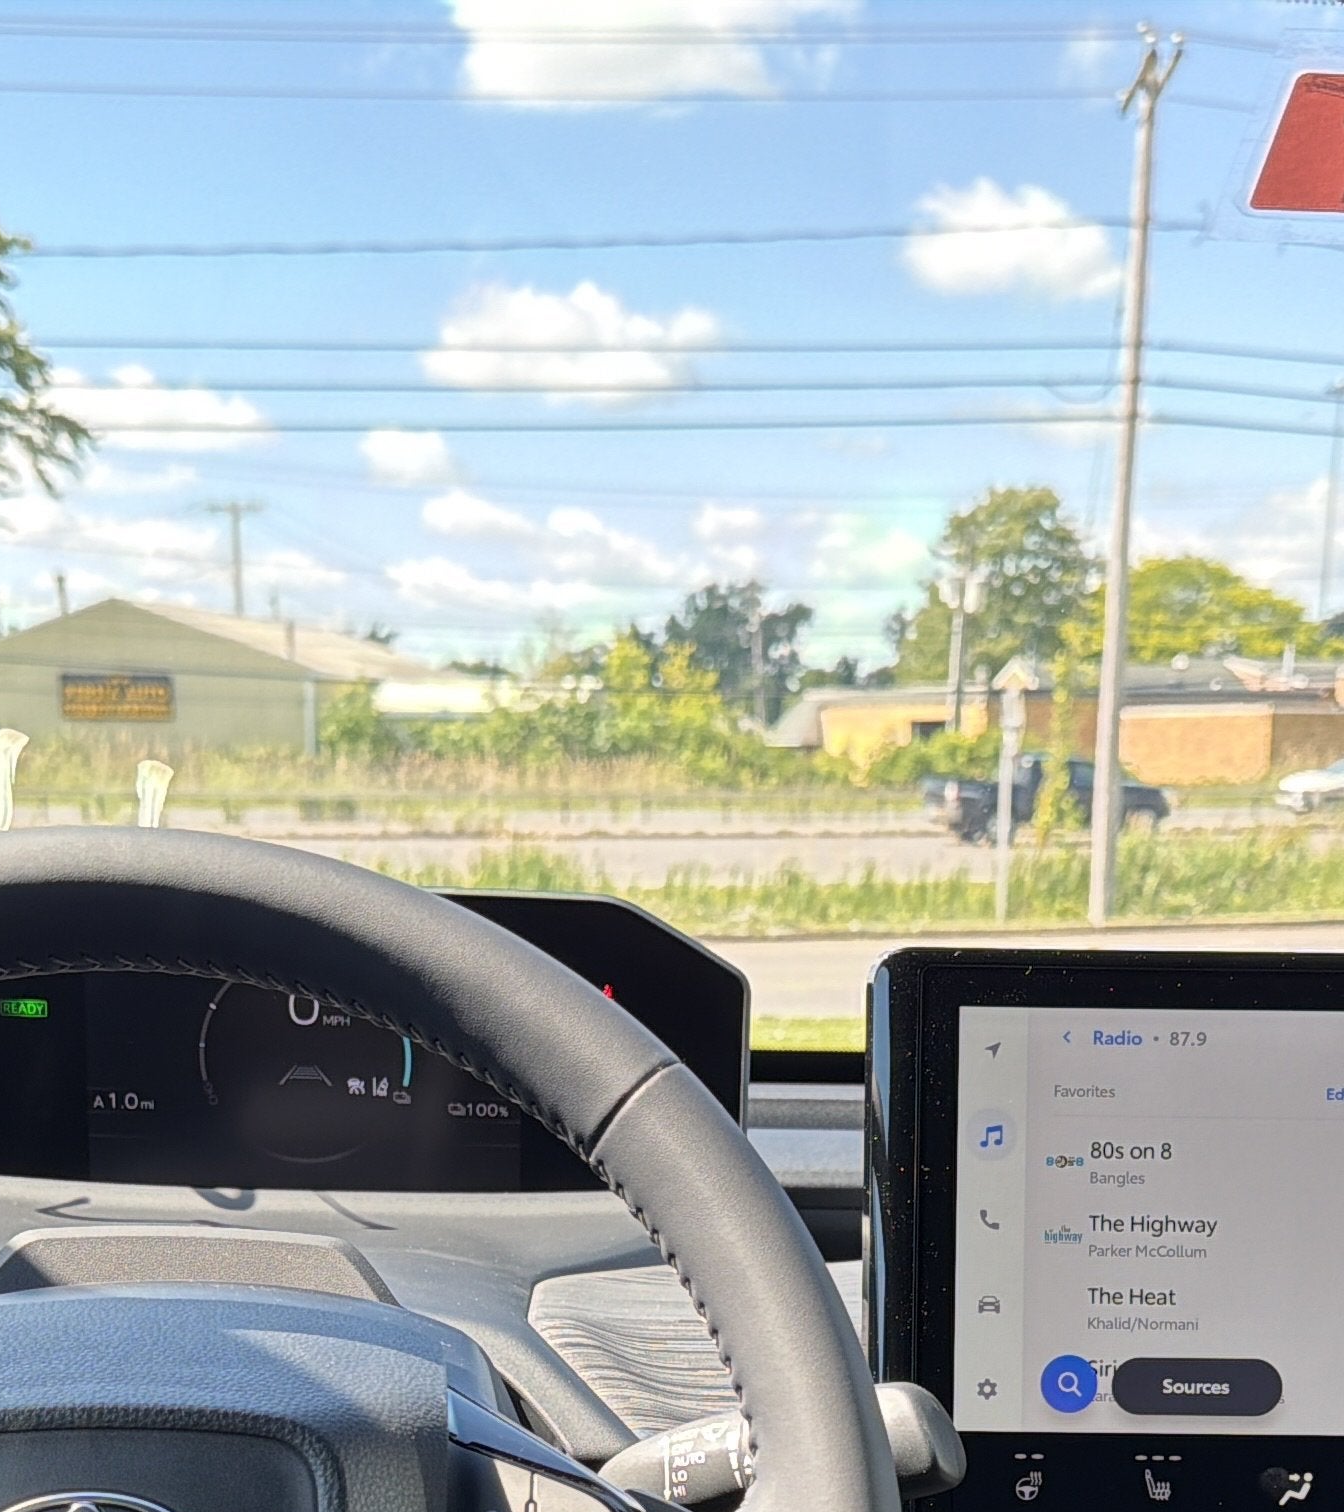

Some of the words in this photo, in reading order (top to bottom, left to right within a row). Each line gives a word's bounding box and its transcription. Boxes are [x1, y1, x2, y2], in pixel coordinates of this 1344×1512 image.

[3, 1003, 44, 1015] READY
[323, 1015, 351, 1027] MPH
[1093, 1030, 1142, 1046] Radio
[1169, 1032, 1207, 1047] 87.9
[1054, 1085, 1116, 1099] Favorites
[93, 1095, 105, 1109] A
[109, 1092, 138, 1110] 1.0
[141, 1100, 155, 1110] mi
[466, 1103, 509, 1117] 100%
[1090, 1142, 1124, 1160] 80s
[1130, 1146, 1155, 1160] on
[1160, 1142, 1173, 1160] 8
[1089, 1172, 1145, 1187] Bangles
[1089, 1215, 1124, 1232] The
[1131, 1215, 1218, 1237] Highway
[1044, 1229, 1083, 1244] highway
[1088, 1245, 1132, 1258] Parker
[1136, 1245, 1207, 1259] McCollum
[1088, 1288, 1123, 1305] The
[1129, 1288, 1176, 1306] Heat
[1087, 1317, 1199, 1332] Khalid/Normani
[1162, 1379, 1230, 1395] Sources
[672, 1451, 706, 1468] AUTO
[671, 1469, 688, 1483] LO
[672, 1484, 687, 1498] HI
